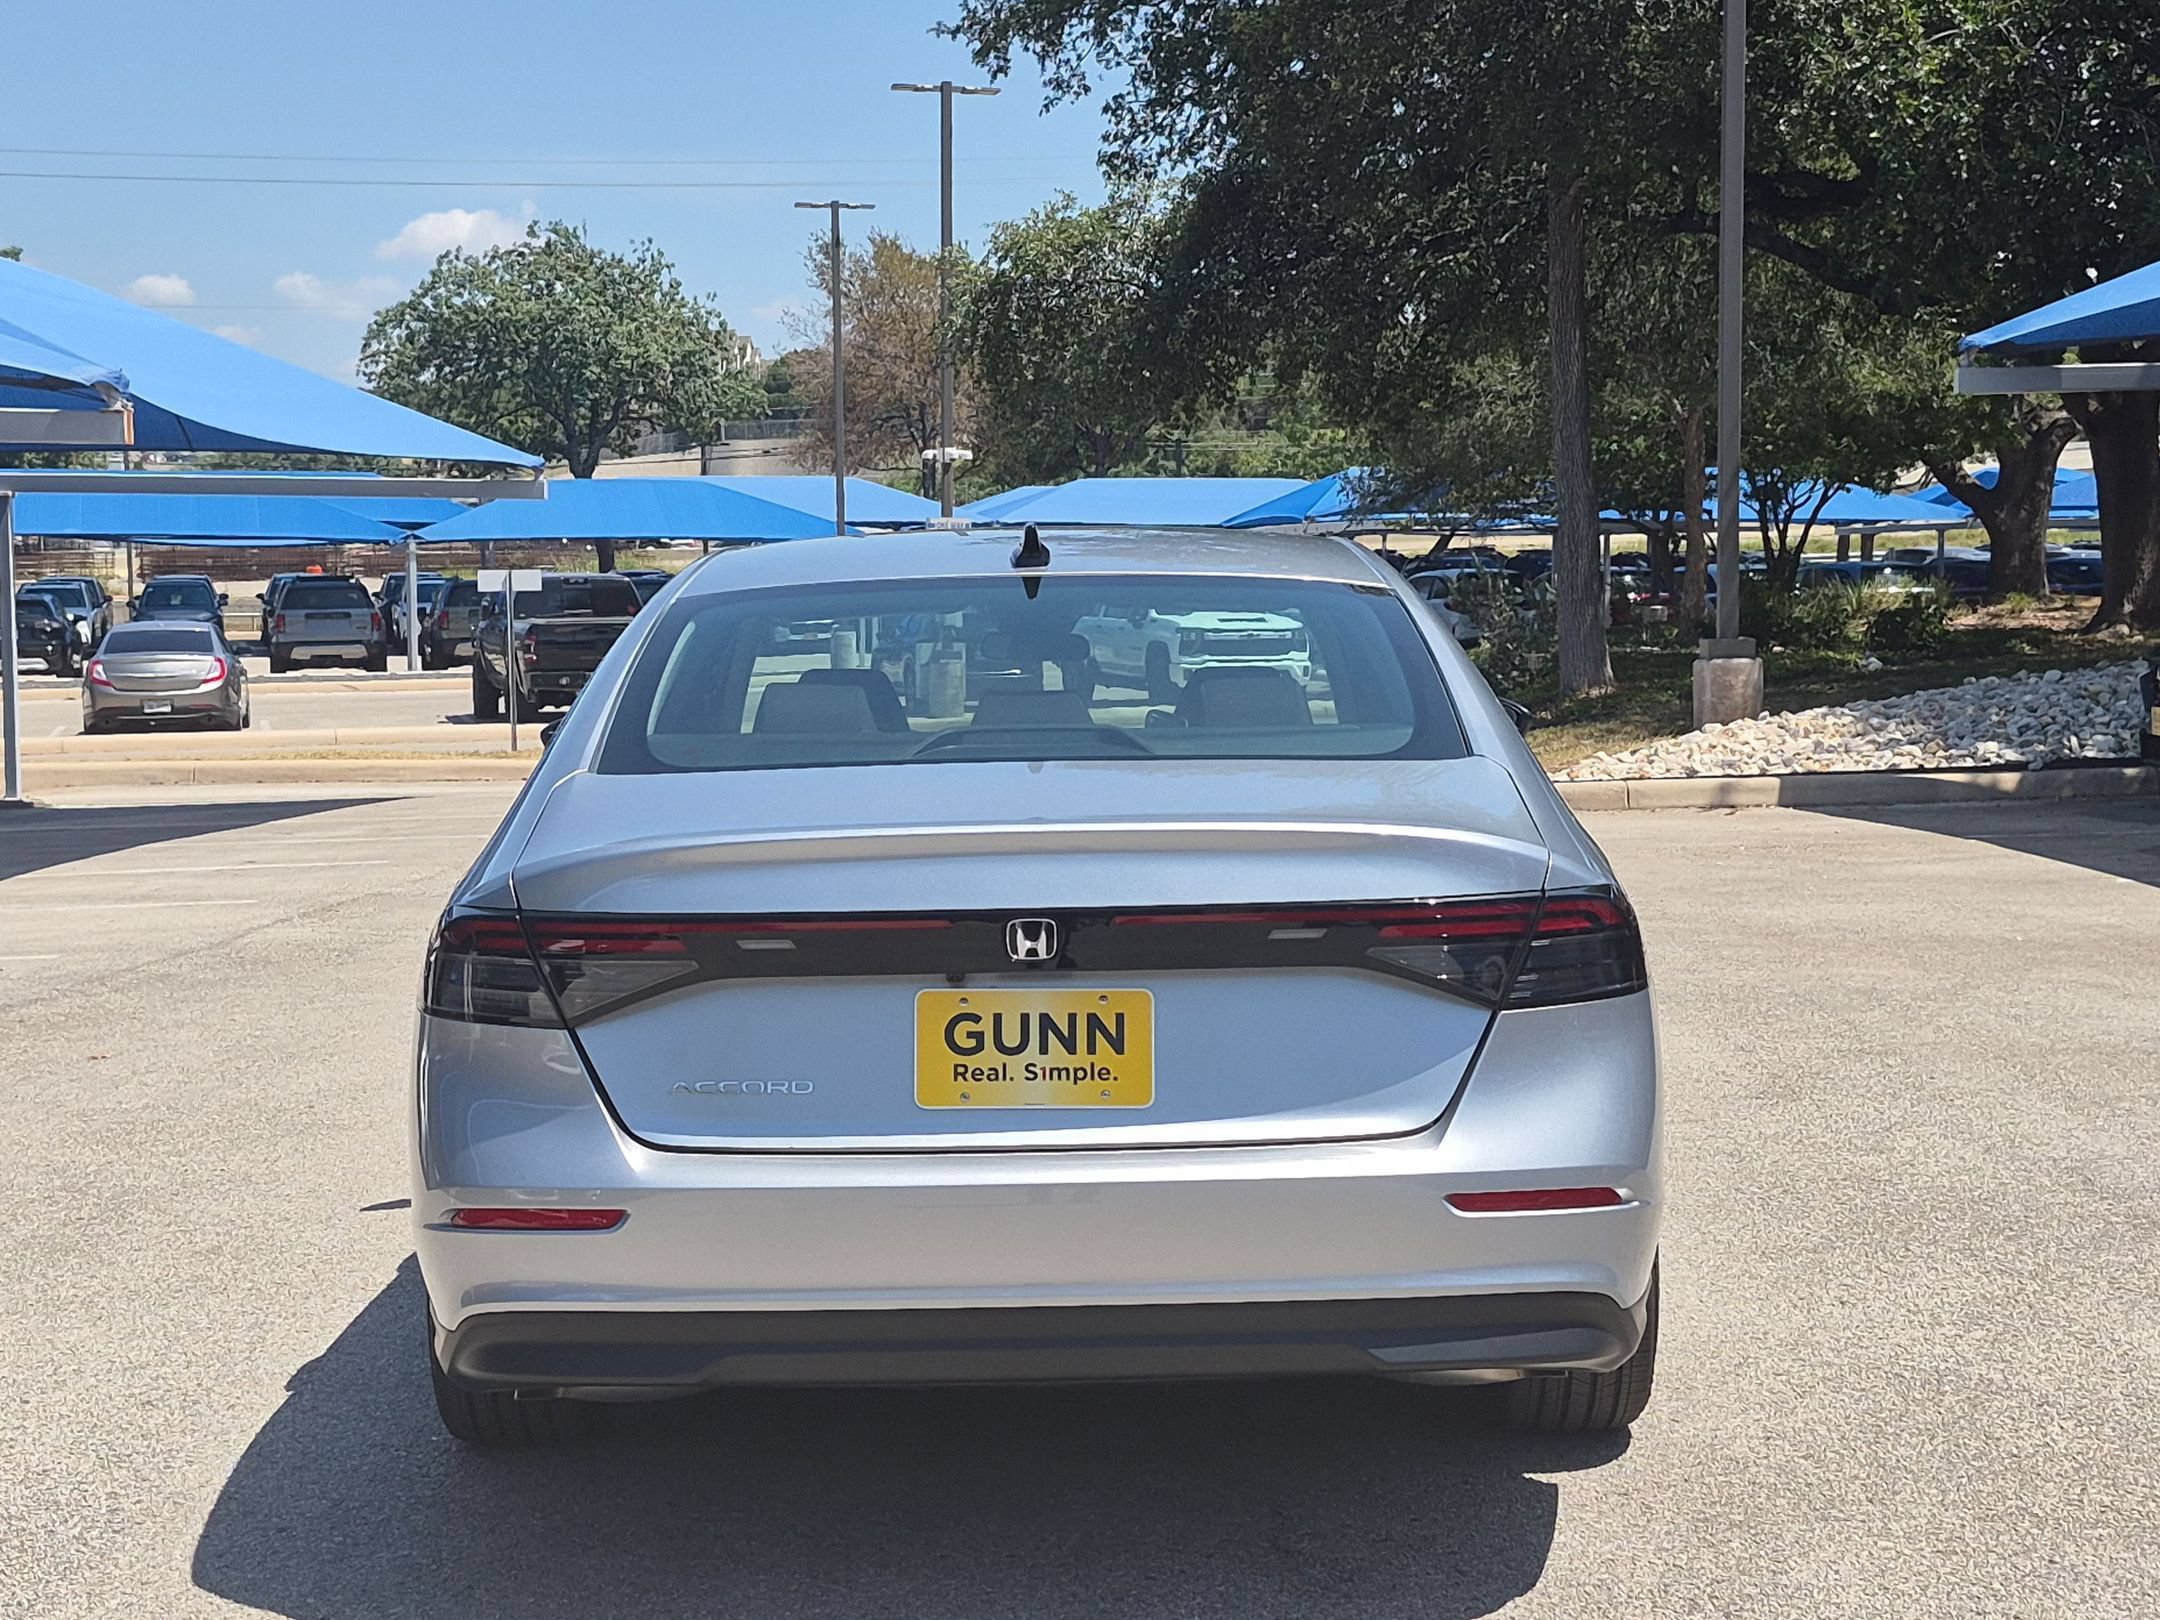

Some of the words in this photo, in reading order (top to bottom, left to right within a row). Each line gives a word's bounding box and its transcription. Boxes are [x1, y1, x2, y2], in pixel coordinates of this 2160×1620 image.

[944, 1012, 1125, 1056] GUNN
[953, 1062, 1014, 1082] Real.
[671, 1080, 815, 1095] ACCORD
